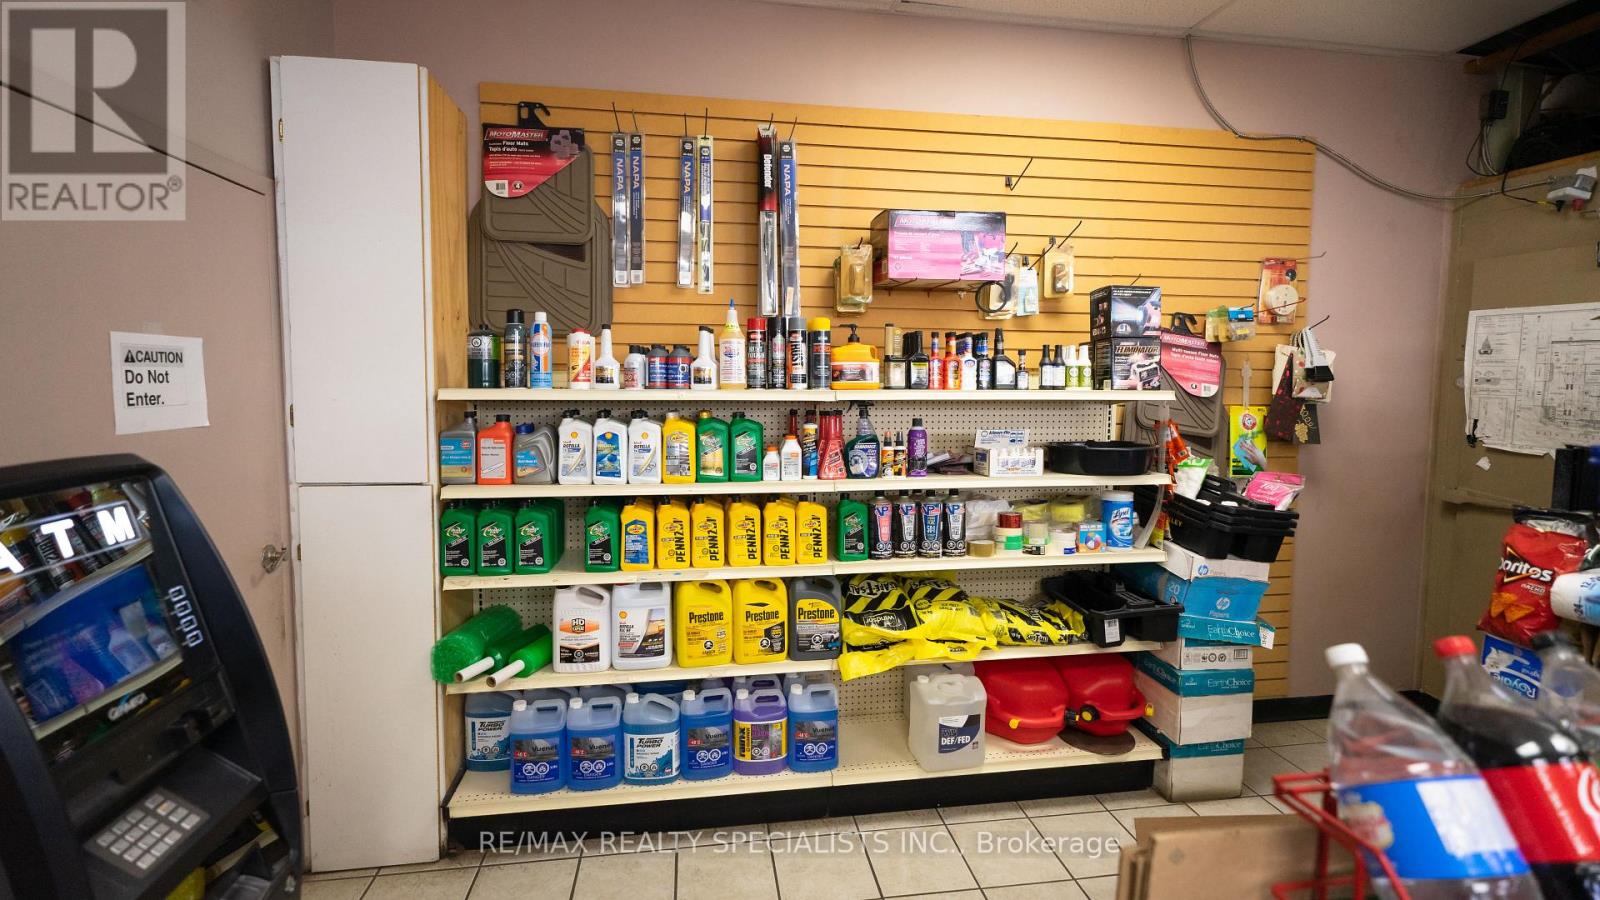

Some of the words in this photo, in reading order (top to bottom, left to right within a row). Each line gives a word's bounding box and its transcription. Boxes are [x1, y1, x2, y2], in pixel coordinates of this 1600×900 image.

[616, 157, 625, 191] NAPA
[632, 155, 640, 190] NAPA
[683, 161, 691, 194] NAPA
[763, 154, 773, 189] Defender
[783, 164, 791, 196] NAPA
[135, 350, 184, 363] CAUTION
[124, 369, 143, 384] Do
[147, 369, 170, 384] Not
[126, 392, 165, 407] Enter.
[1168, 583, 1180, 594] 20
[689, 611, 724, 624] Prestone
[745, 610, 780, 622] Prestone
[797, 607, 835, 620] Prestone
[1207, 624, 1256, 638] EarthChoice
[1207, 678, 1252, 689] EarthChoice
[941, 735, 971, 746] DEF/FED
